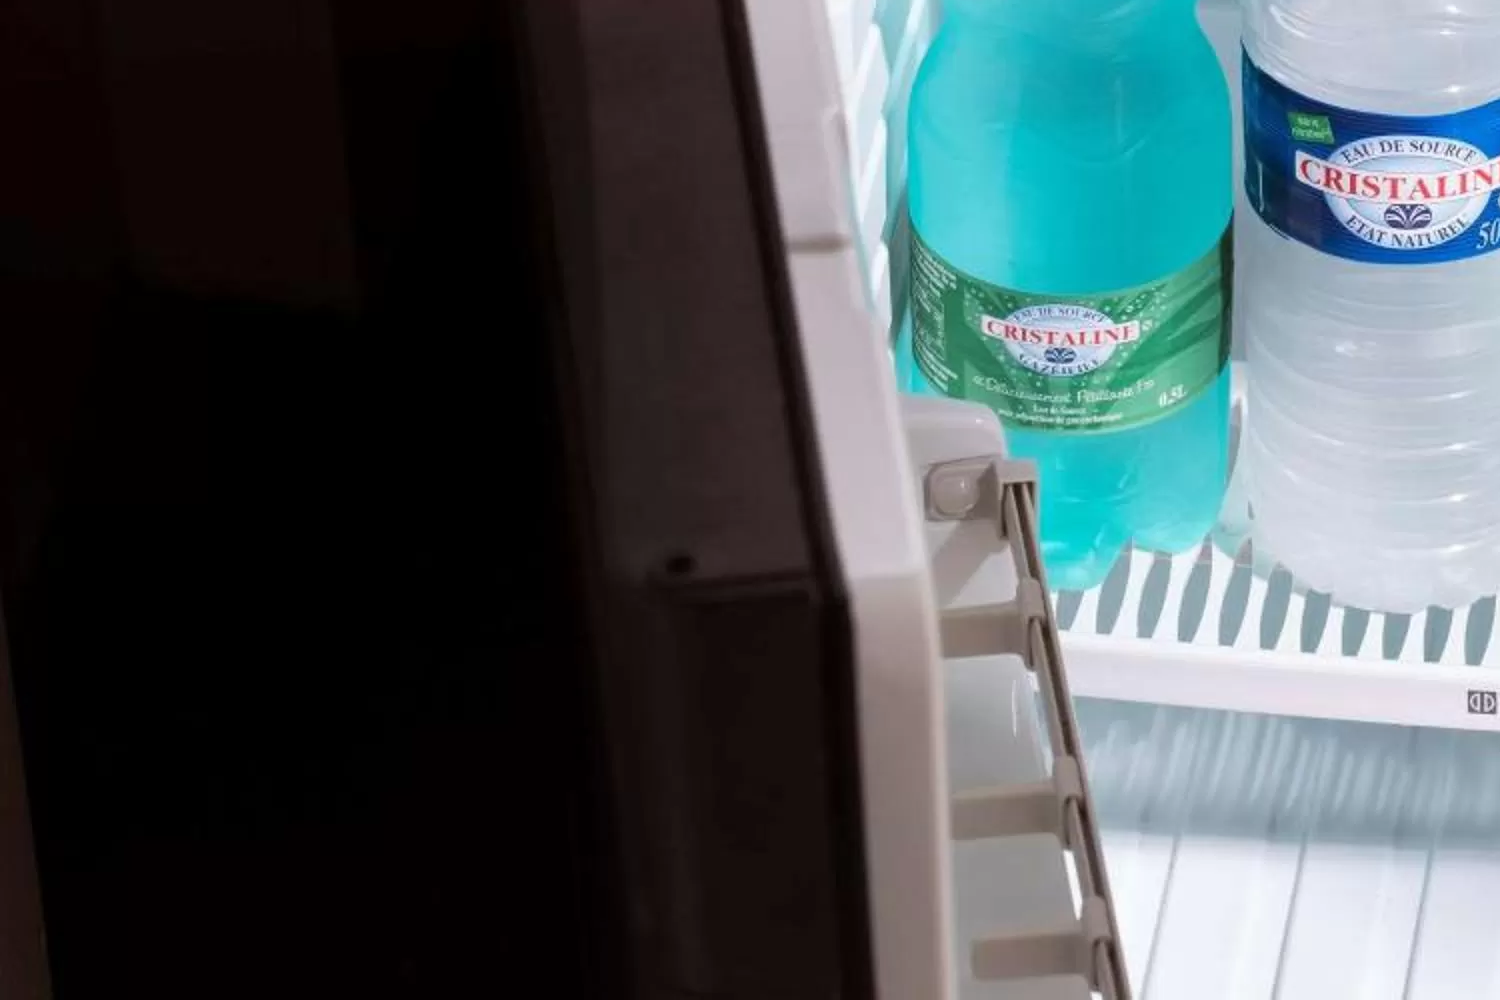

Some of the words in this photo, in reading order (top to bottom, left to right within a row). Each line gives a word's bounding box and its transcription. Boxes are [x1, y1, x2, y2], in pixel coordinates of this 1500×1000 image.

[1340, 141, 1375, 164] EAU
[1379, 139, 1405, 153] DE
[1408, 139, 1477, 162] SOURCE
[1346, 214, 1388, 243] ETAT
[1391, 217, 1469, 247] NATUREL
[986, 319, 1135, 346] CRISTALINE
